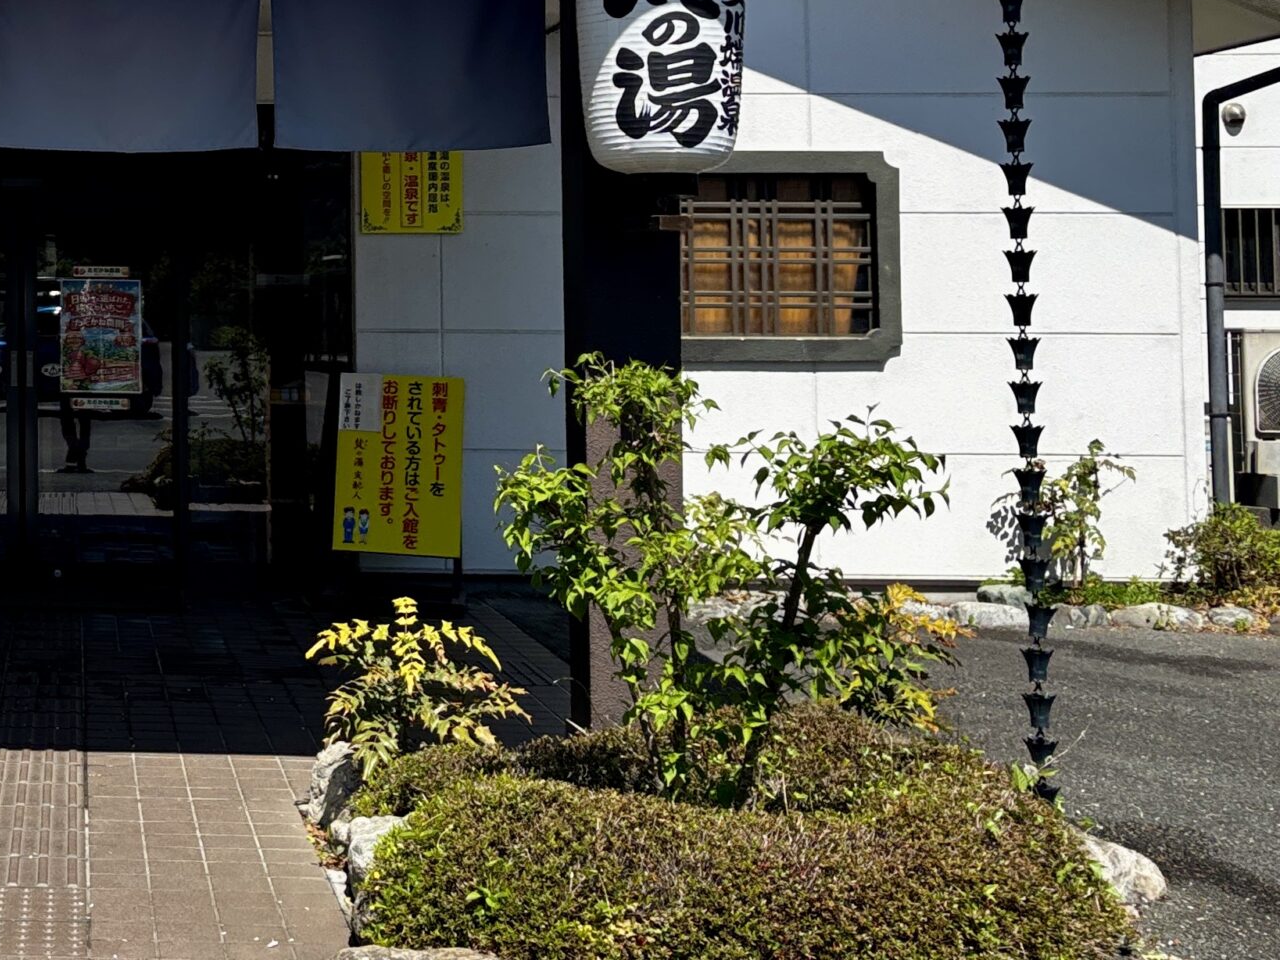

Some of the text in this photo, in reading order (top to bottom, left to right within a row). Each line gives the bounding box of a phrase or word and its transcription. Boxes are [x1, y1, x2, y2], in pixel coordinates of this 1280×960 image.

[379, 379, 400, 525] お断りしております。
[402, 381, 423, 550] されている方はご入館を
[430, 382, 448, 497] 刺青・タトゥーを
